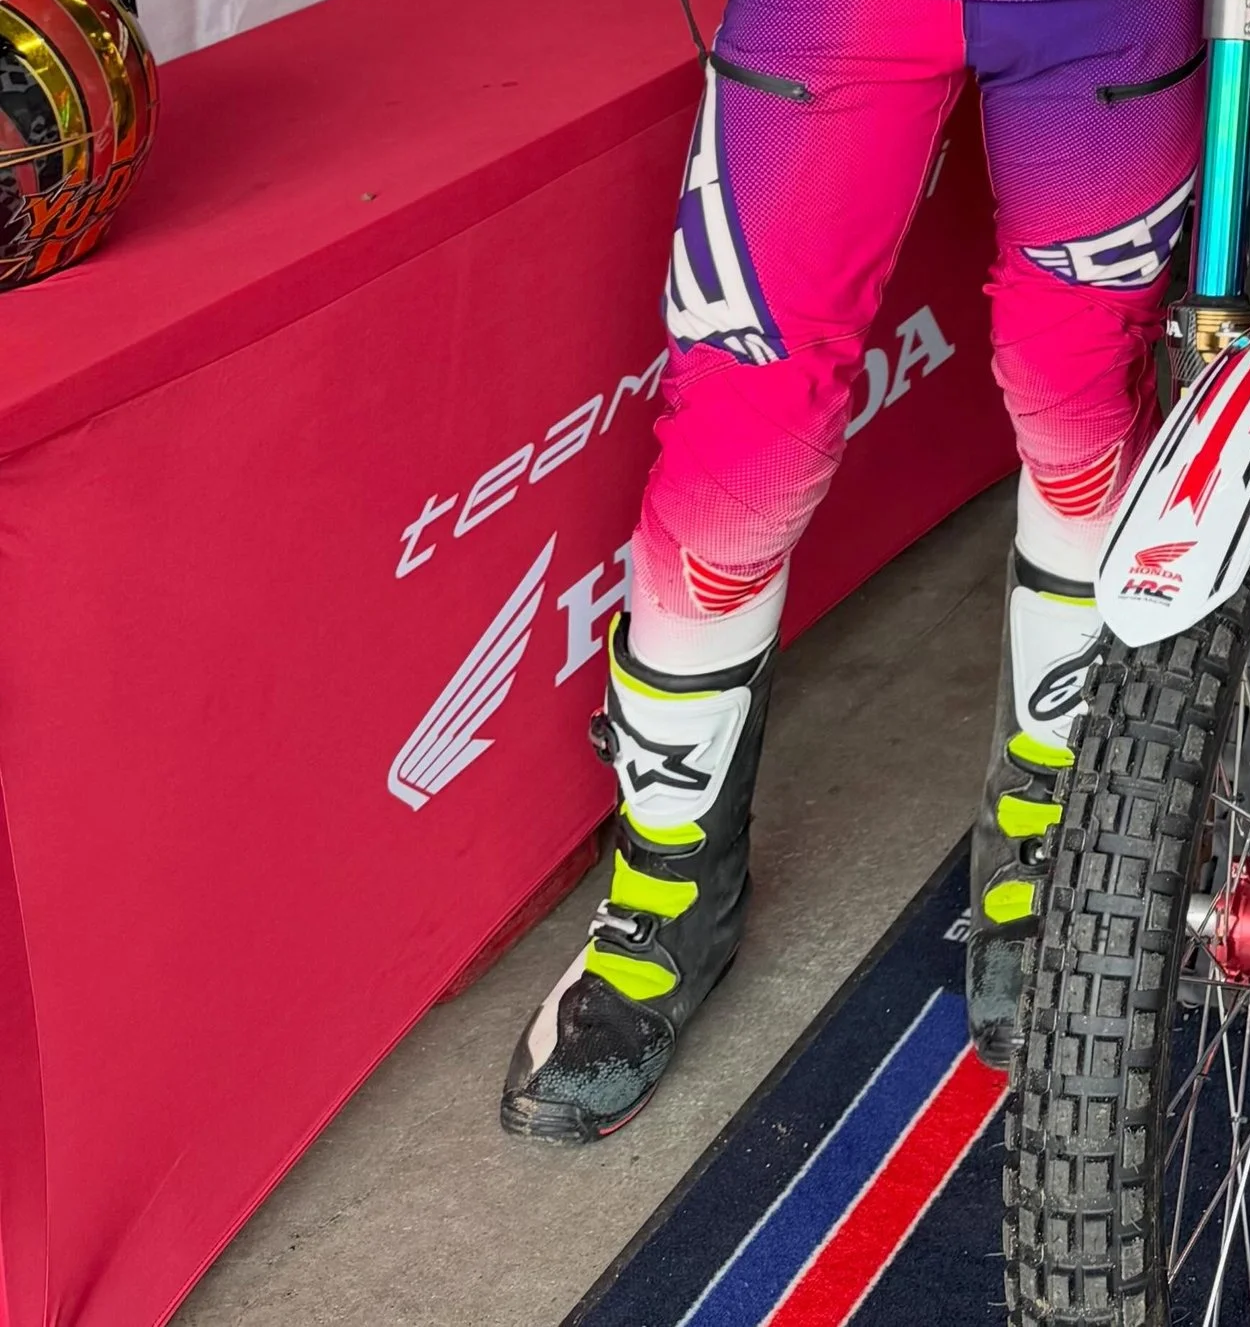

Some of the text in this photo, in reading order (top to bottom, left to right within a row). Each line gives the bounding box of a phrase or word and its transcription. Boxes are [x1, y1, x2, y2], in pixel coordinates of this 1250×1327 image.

[395, 348, 669, 579] team
[1128, 567, 1184, 583] HONDA
[1120, 578, 1181, 602] HRC
